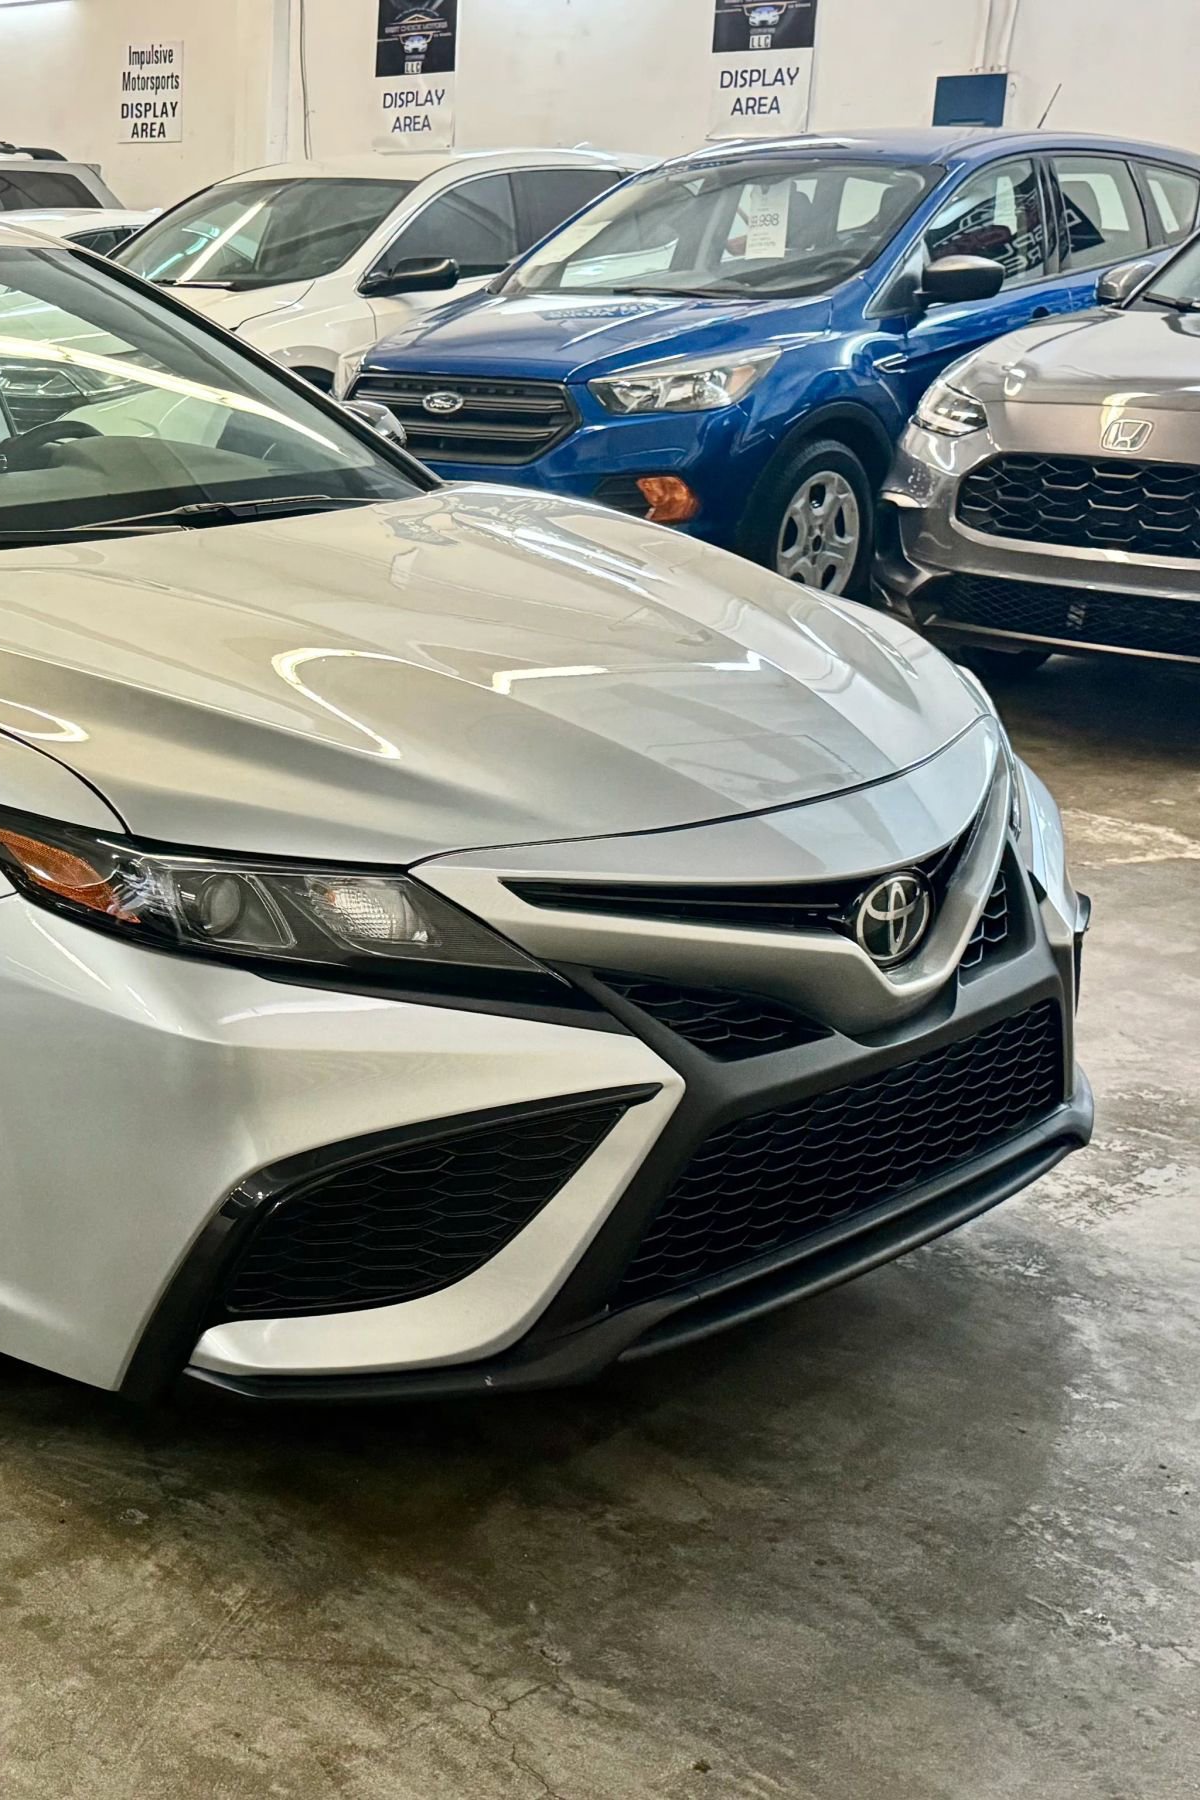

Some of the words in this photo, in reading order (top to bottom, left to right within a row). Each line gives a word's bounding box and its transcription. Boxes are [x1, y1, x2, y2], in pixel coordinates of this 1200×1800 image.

[751, 35, 771, 48] LLC
[128, 44, 174, 70] Impulsive
[122, 71, 180, 95] Motorsports
[720, 67, 800, 89] DISPLAY
[383, 89, 446, 109] DISPLAY
[730, 96, 781, 116] AREA
[121, 101, 179, 119] DISPLAY
[130, 121, 167, 138] AREA
[391, 114, 432, 132] AREA
